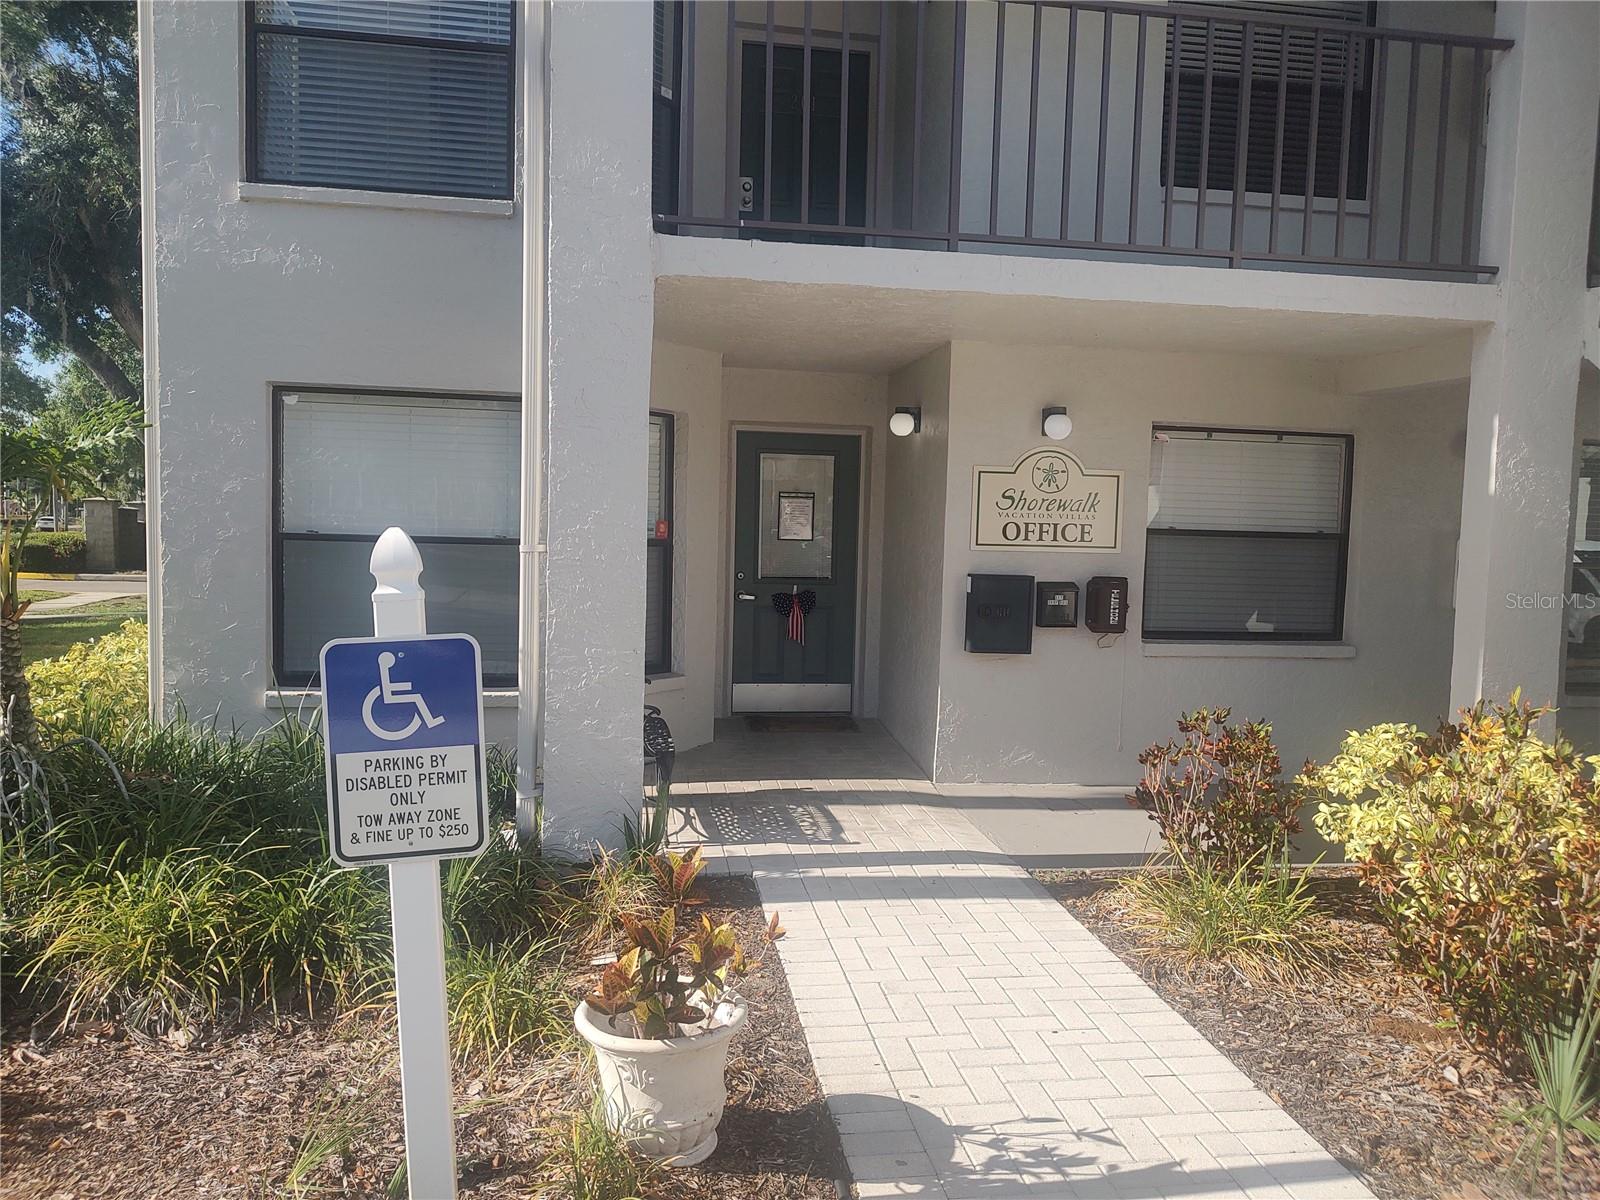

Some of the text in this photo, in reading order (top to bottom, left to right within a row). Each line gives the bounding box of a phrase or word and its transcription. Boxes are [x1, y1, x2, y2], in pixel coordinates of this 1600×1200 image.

[996, 488, 1100, 512] Shorewalk
[997, 511, 1096, 521] VACATION VILLAS
[1002, 521, 1093, 543] OFFICE
[364, 753, 447, 773] PARKING BY
[345, 770, 468, 792] DISABLED PERMIT
[390, 790, 426, 807] ONLY
[357, 807, 461, 828] TOW AWAY ZONE
[350, 823, 469, 845] & FINE UP TO $250
